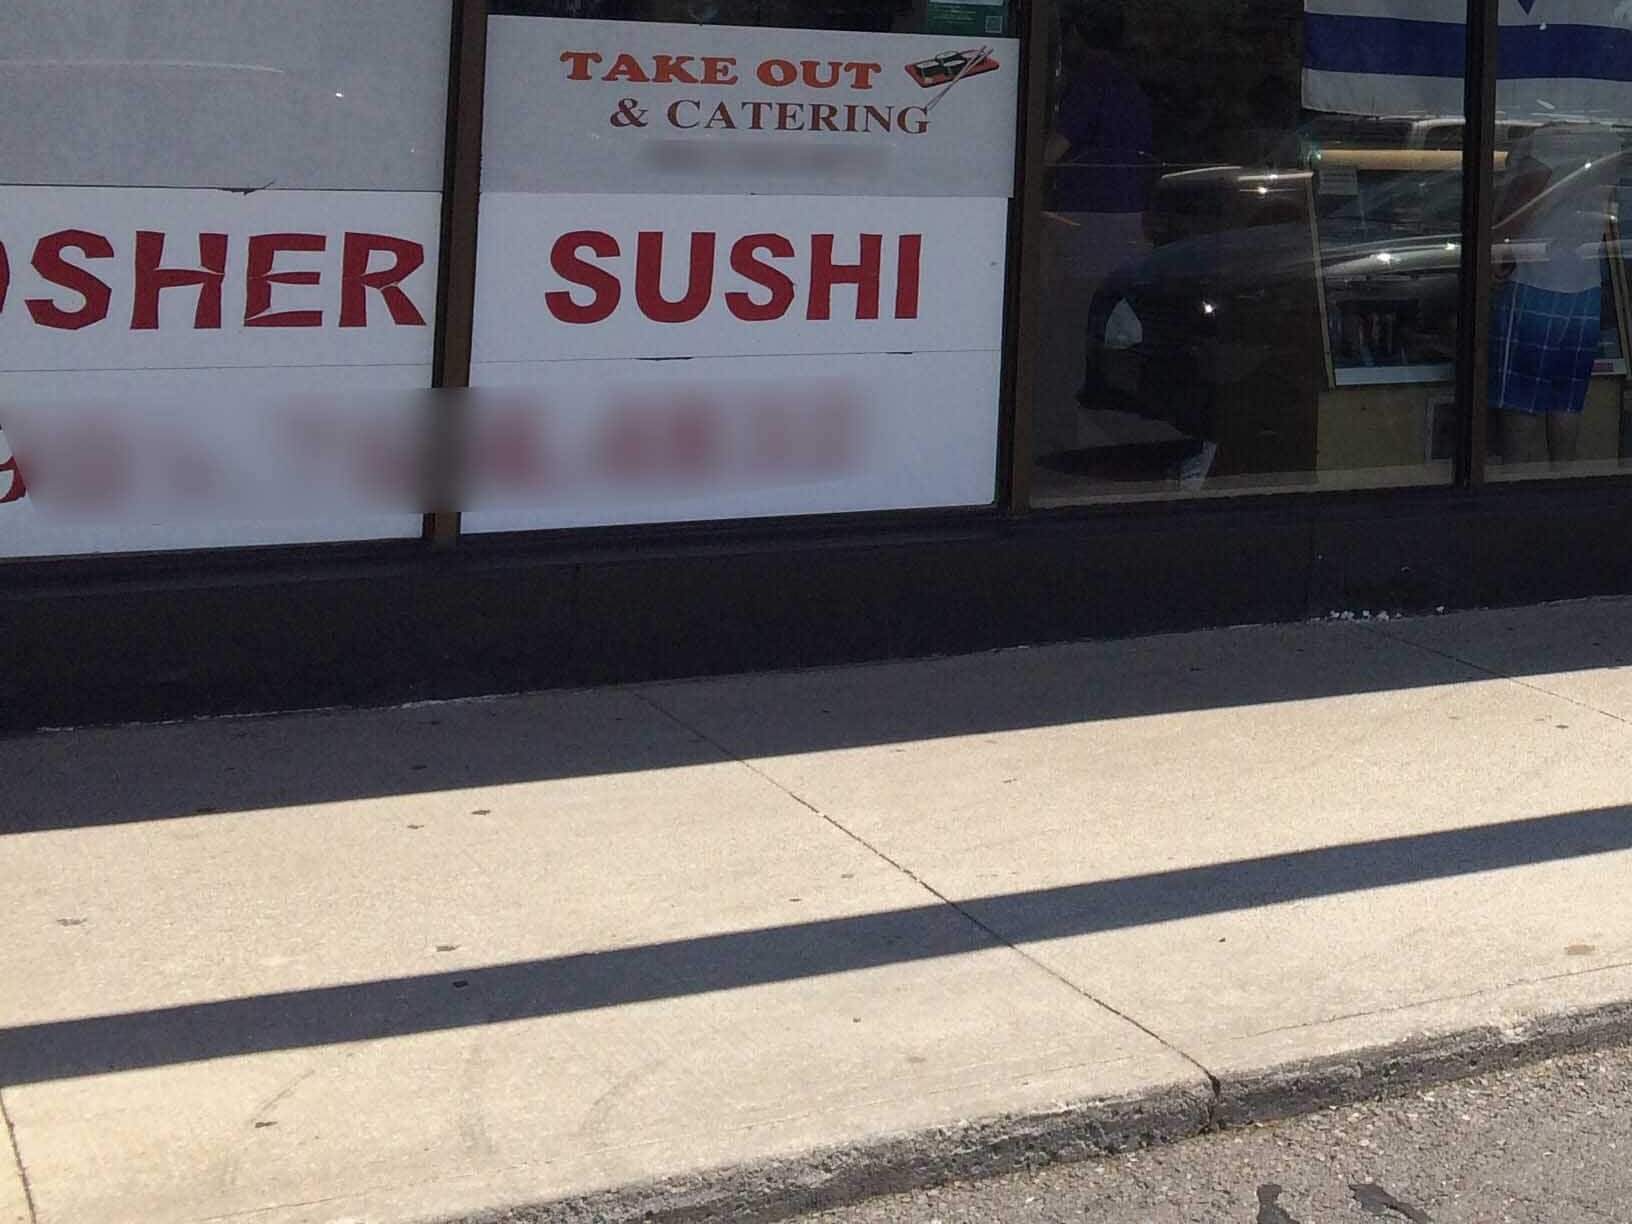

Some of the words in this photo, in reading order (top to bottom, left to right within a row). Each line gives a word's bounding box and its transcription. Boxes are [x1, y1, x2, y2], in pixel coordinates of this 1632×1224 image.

[560, 51, 738, 84] TAKE
[756, 60, 882, 90] OUT
[609, 97, 649, 128] &
[667, 99, 931, 135] CATERING
[0, 228, 427, 331] SHER
[544, 230, 922, 325] SUSHI
